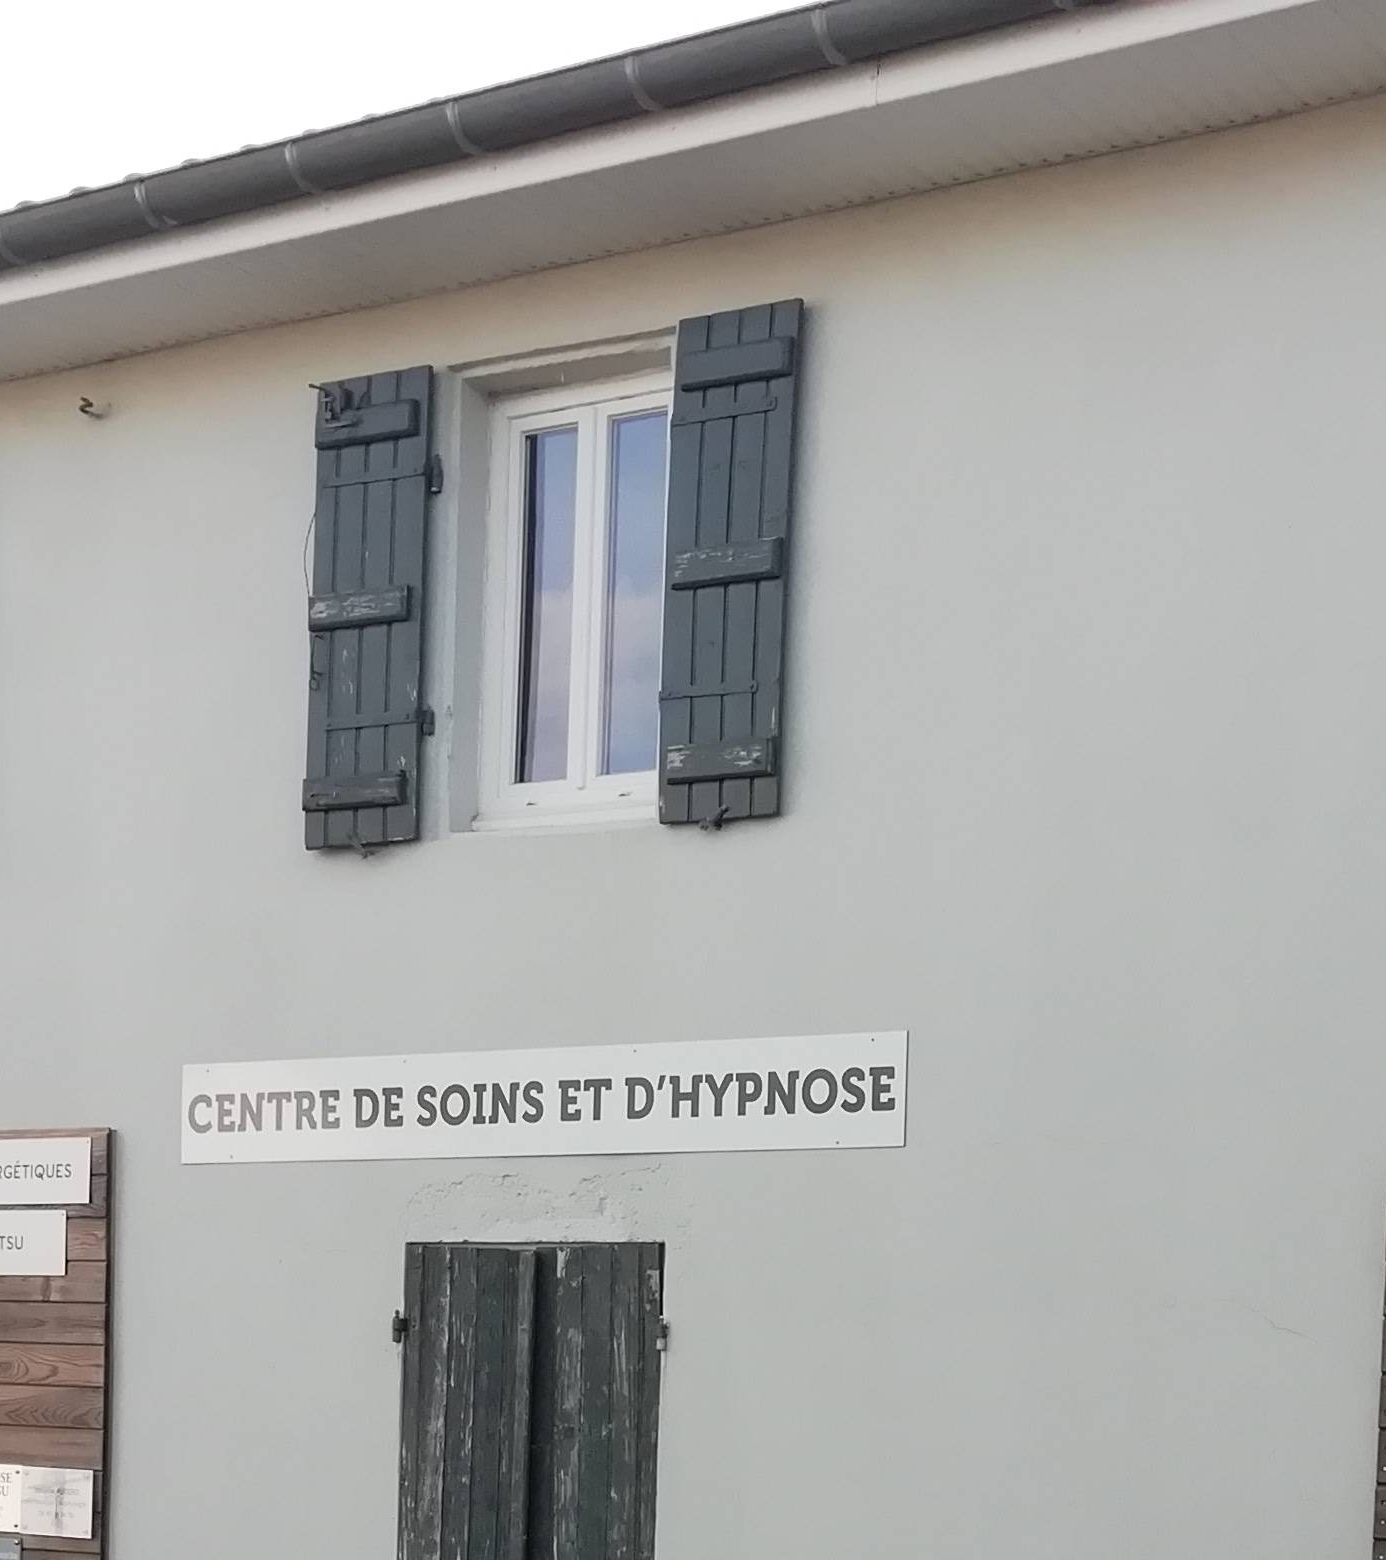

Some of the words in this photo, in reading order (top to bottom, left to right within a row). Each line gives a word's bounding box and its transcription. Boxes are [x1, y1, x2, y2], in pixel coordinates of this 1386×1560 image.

[188, 1089, 341, 1134] CENTRE
[353, 1087, 404, 1128] DE
[416, 1080, 545, 1127] SOINS
[558, 1078, 612, 1122] ET
[625, 1066, 896, 1120] D'HYPNOSE
